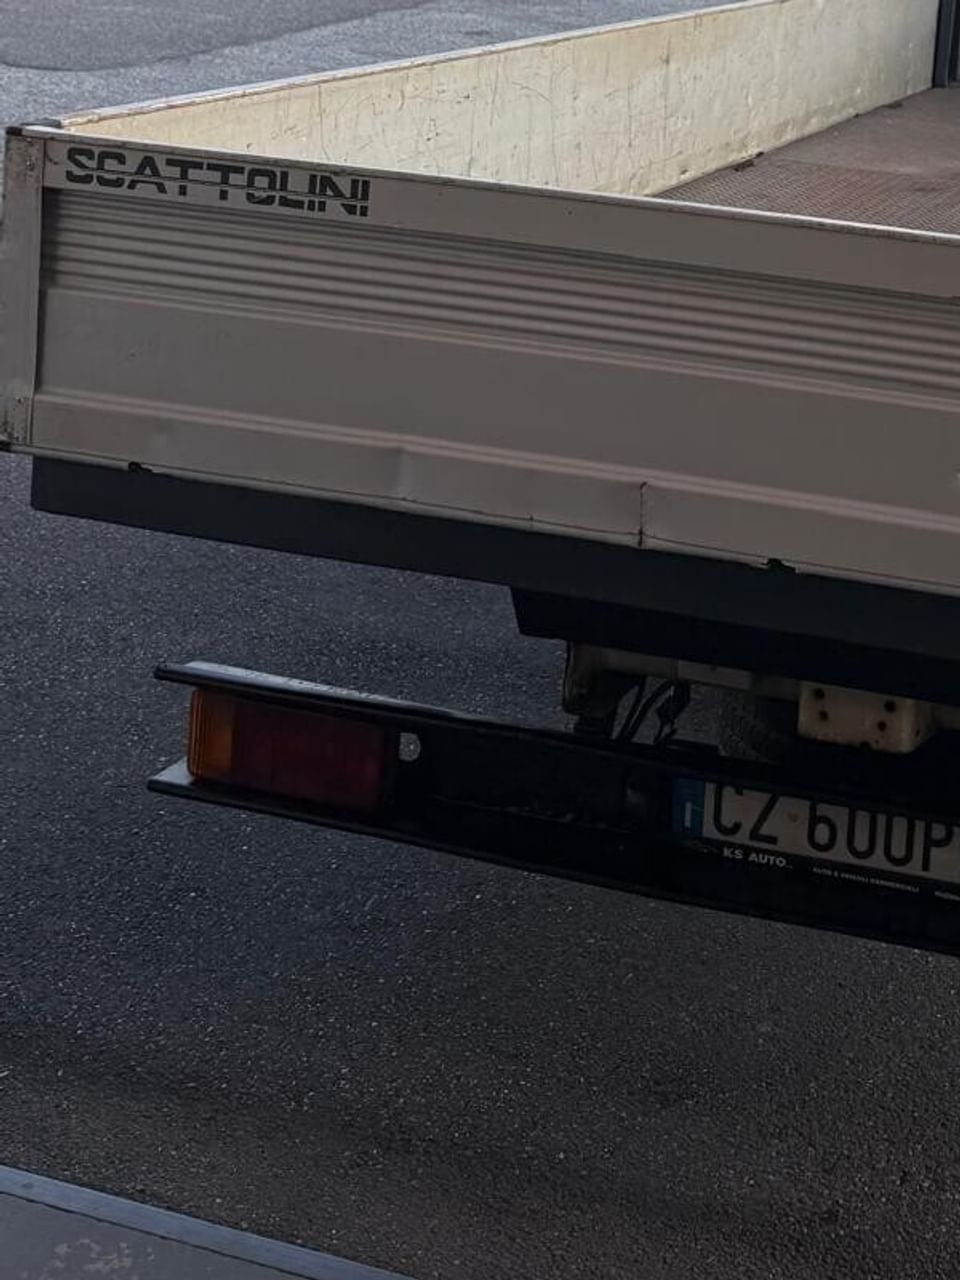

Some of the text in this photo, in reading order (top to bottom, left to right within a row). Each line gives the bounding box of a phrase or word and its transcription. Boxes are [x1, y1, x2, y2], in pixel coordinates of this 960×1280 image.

[65, 146, 371, 217] SCATTOLINI
[711, 783, 780, 846] CZ
[722, 847, 787, 869] KS AUTO
